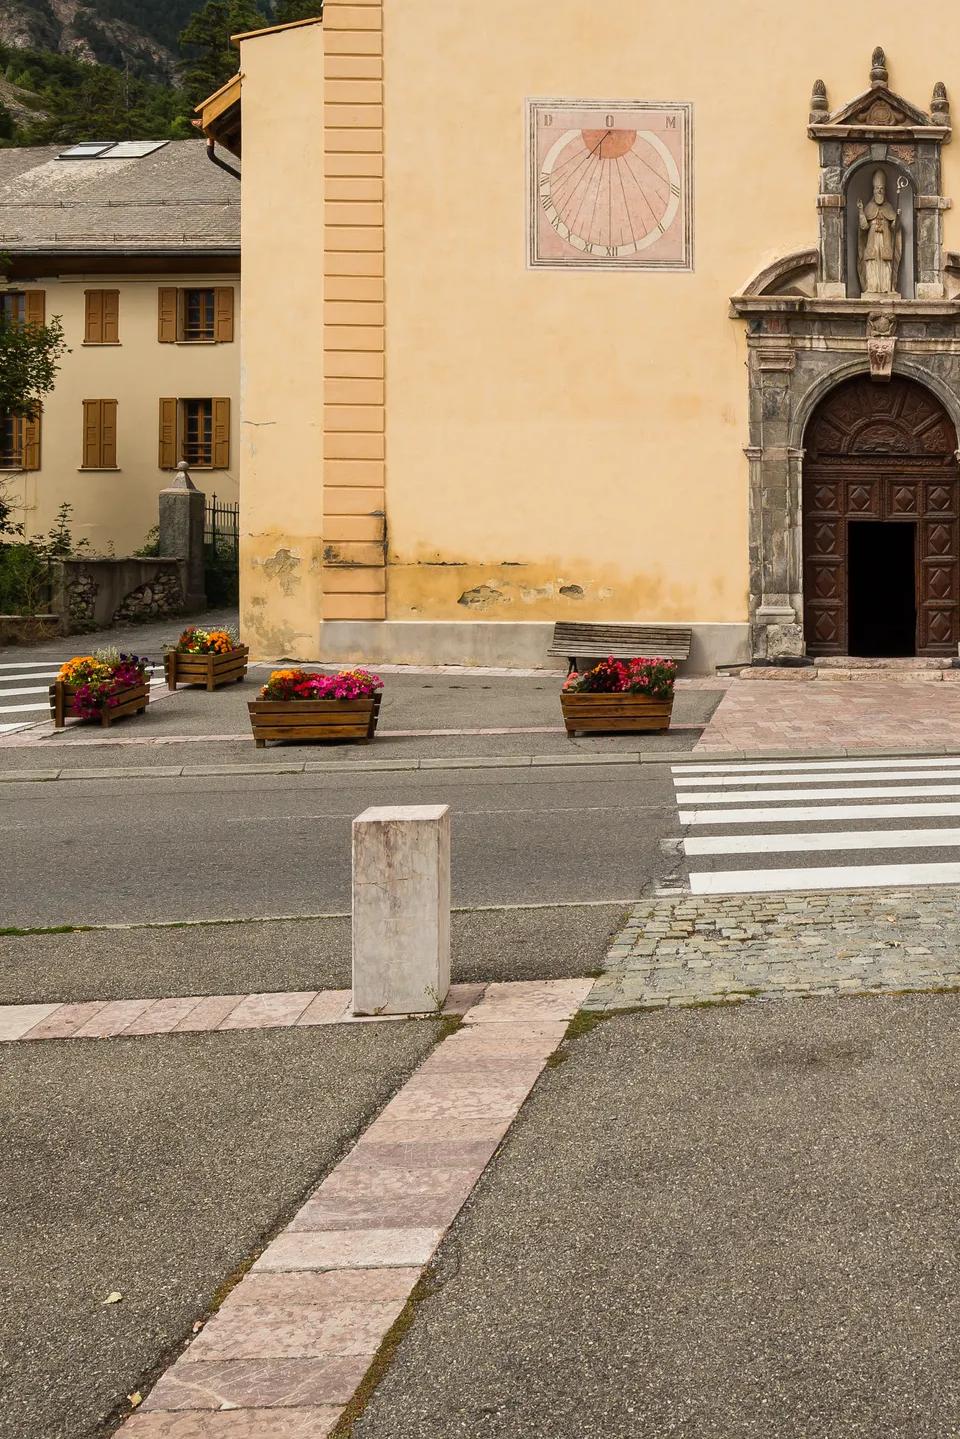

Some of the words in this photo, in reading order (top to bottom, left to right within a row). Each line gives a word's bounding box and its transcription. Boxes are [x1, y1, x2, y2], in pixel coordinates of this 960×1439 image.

[544, 114, 553, 126] D
[605, 115, 614, 127] O
[665, 116, 676, 129] M
[551, 216, 562, 231] IX
[565, 230, 573, 243] X
[583, 241, 594, 253] XI
[606, 246, 618, 257] XII
